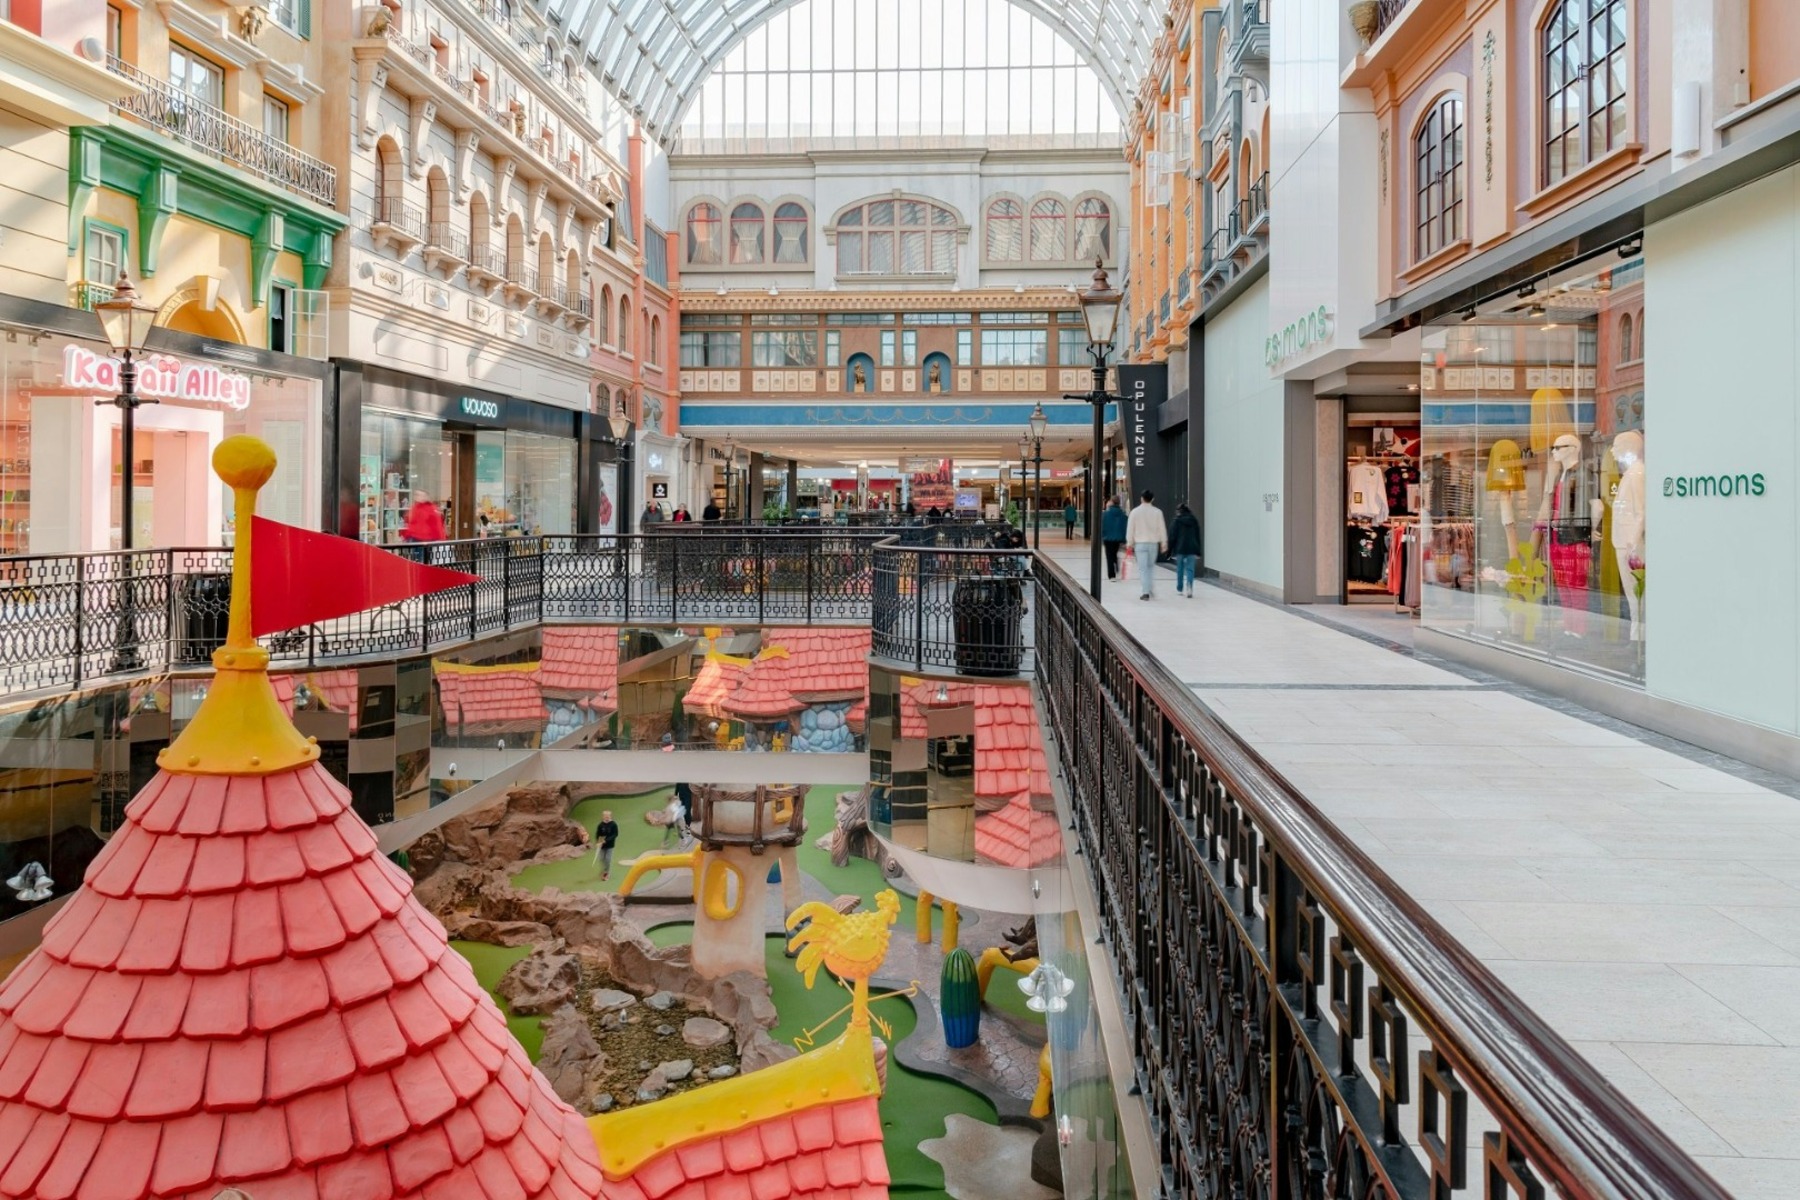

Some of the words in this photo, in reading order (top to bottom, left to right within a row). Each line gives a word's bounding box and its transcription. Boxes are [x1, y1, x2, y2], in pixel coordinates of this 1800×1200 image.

[185, 368, 248, 405] Alley
[1135, 381, 1145, 466] OPULENCE
[1676, 473, 1765, 497] simons
